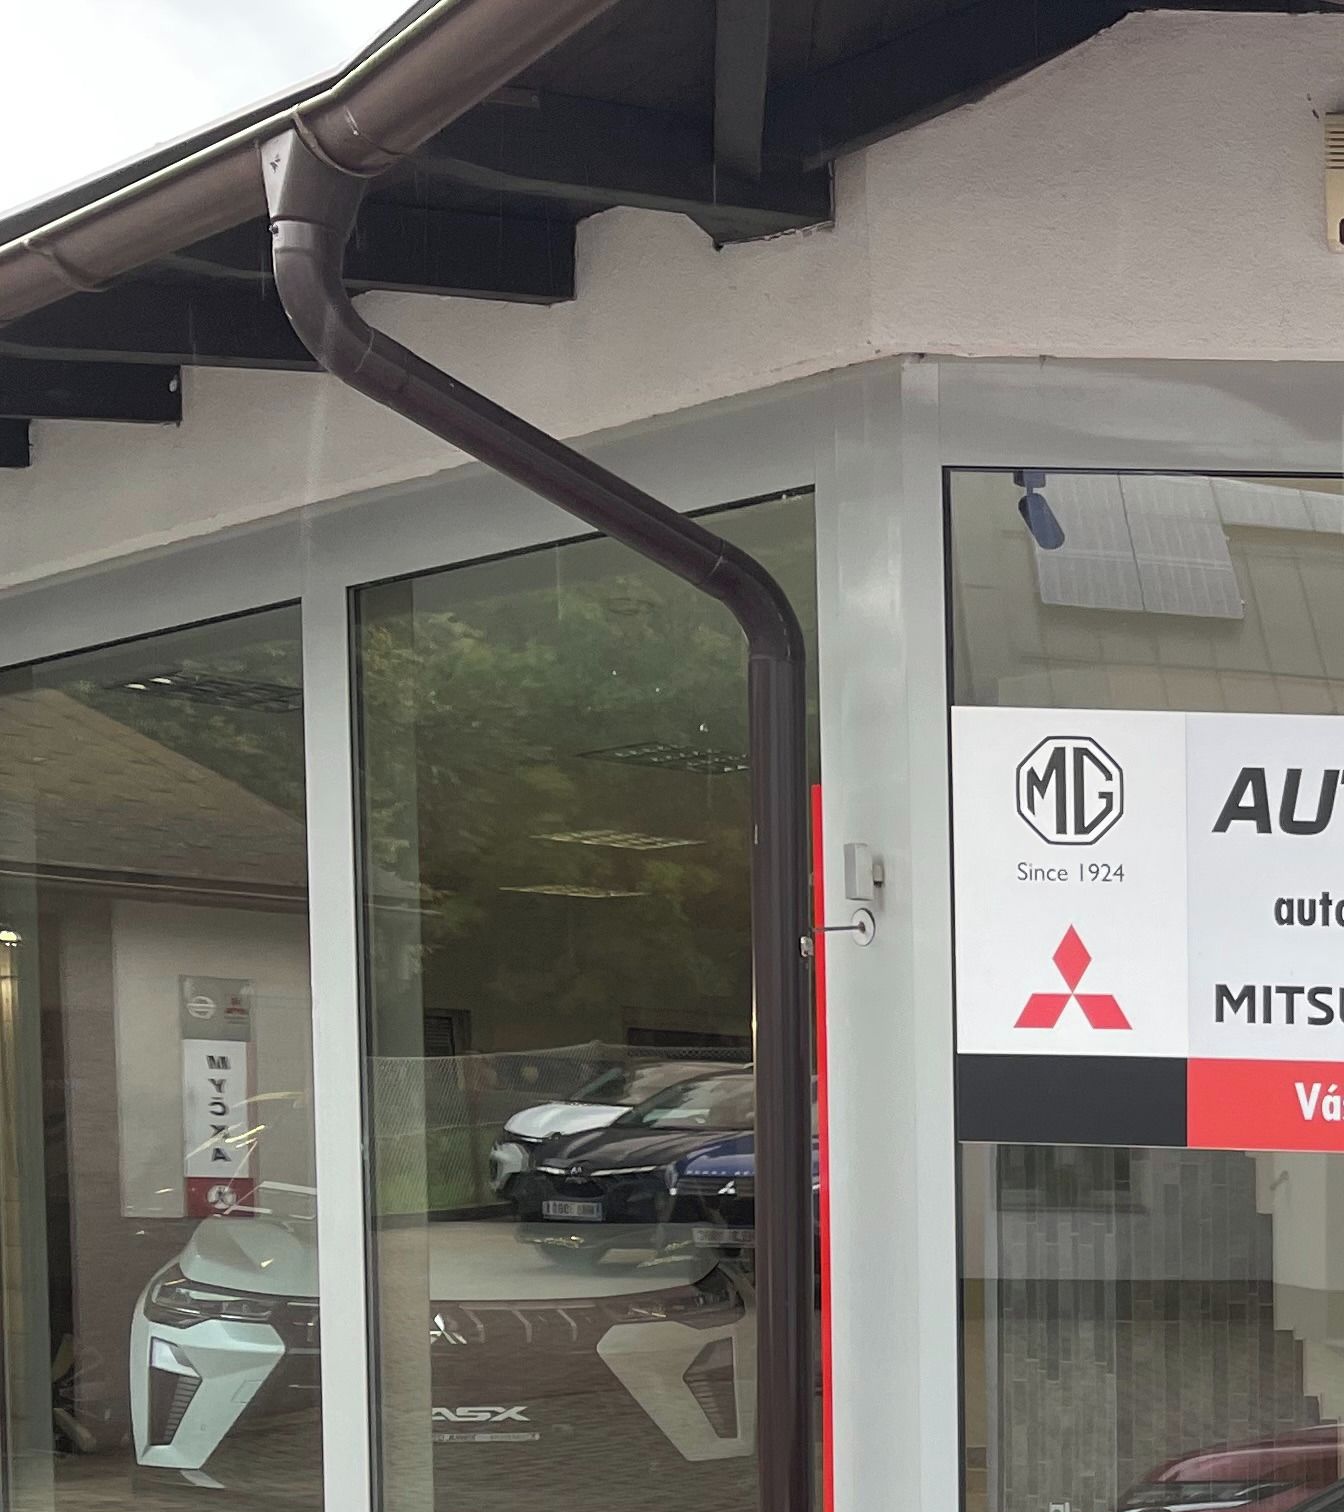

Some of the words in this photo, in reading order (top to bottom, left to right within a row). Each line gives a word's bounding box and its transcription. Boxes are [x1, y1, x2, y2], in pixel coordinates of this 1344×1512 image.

[1026, 745, 1114, 836] MG
[1017, 862, 1068, 882] Since
[1080, 863, 1125, 882] 1924
[432, 1406, 531, 1421] ASX
